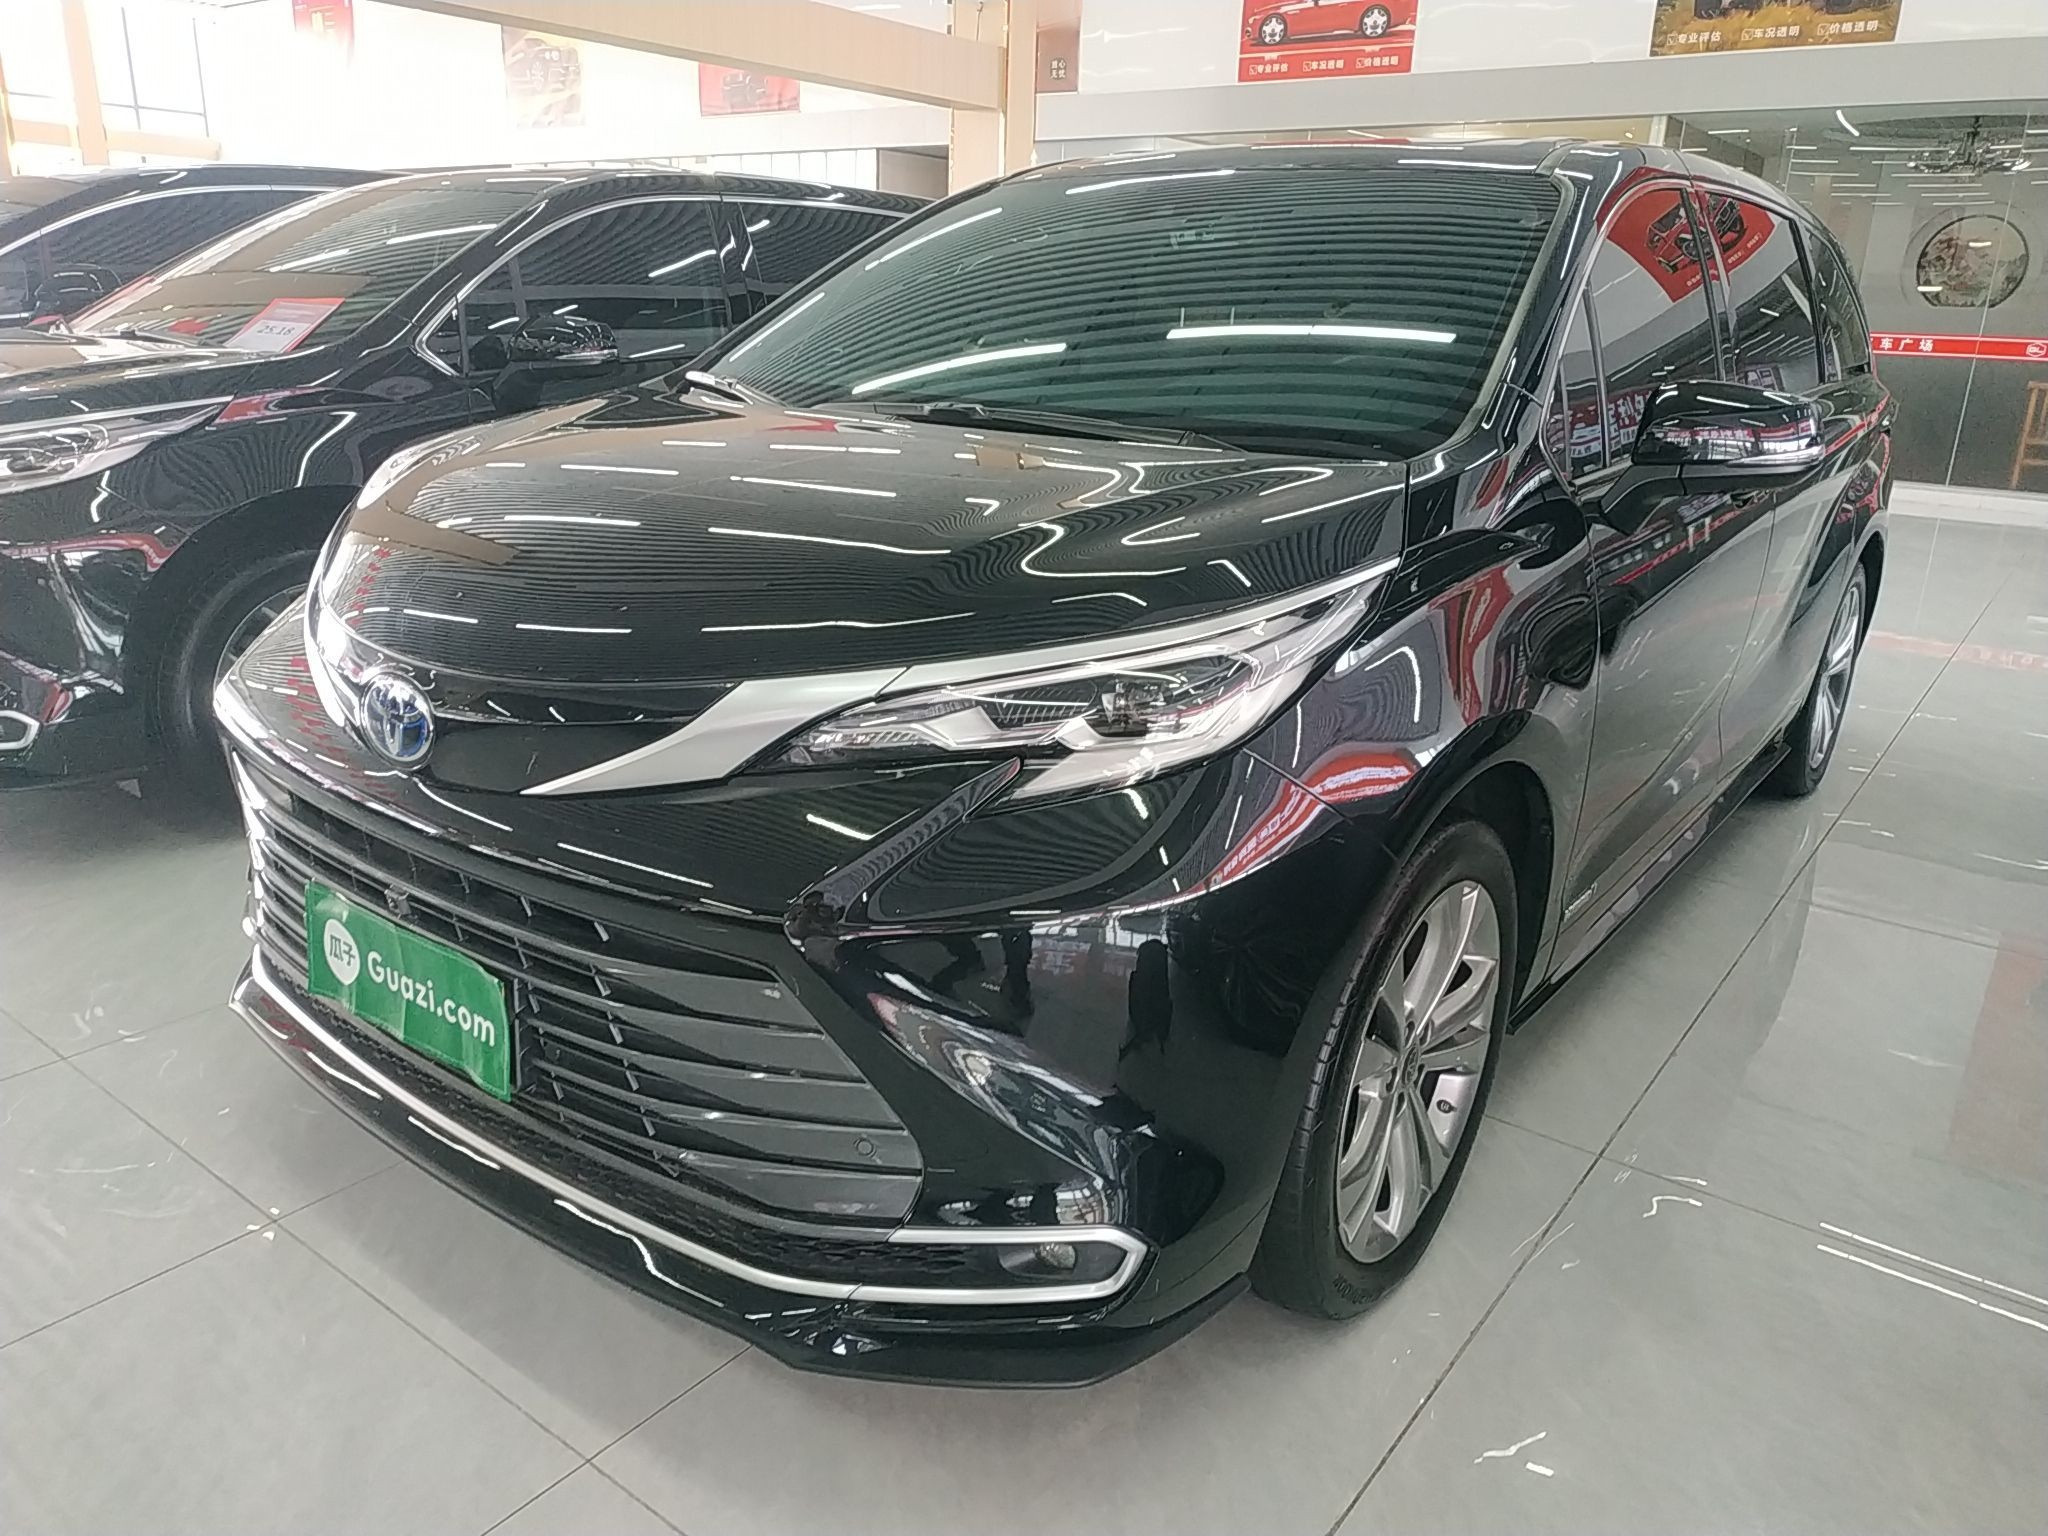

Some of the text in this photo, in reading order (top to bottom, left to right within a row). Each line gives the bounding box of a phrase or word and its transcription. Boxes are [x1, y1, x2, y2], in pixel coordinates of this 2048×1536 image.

[1754, 25, 1800, 38] 车况透明
[1829, 20, 1878, 34] 价格透明
[1678, 31, 1722, 43] 专业评估
[1871, 337, 1934, 352] 车广场
[329, 934, 356, 967] 瓜子
[367, 951, 495, 1047] Guazi.com
